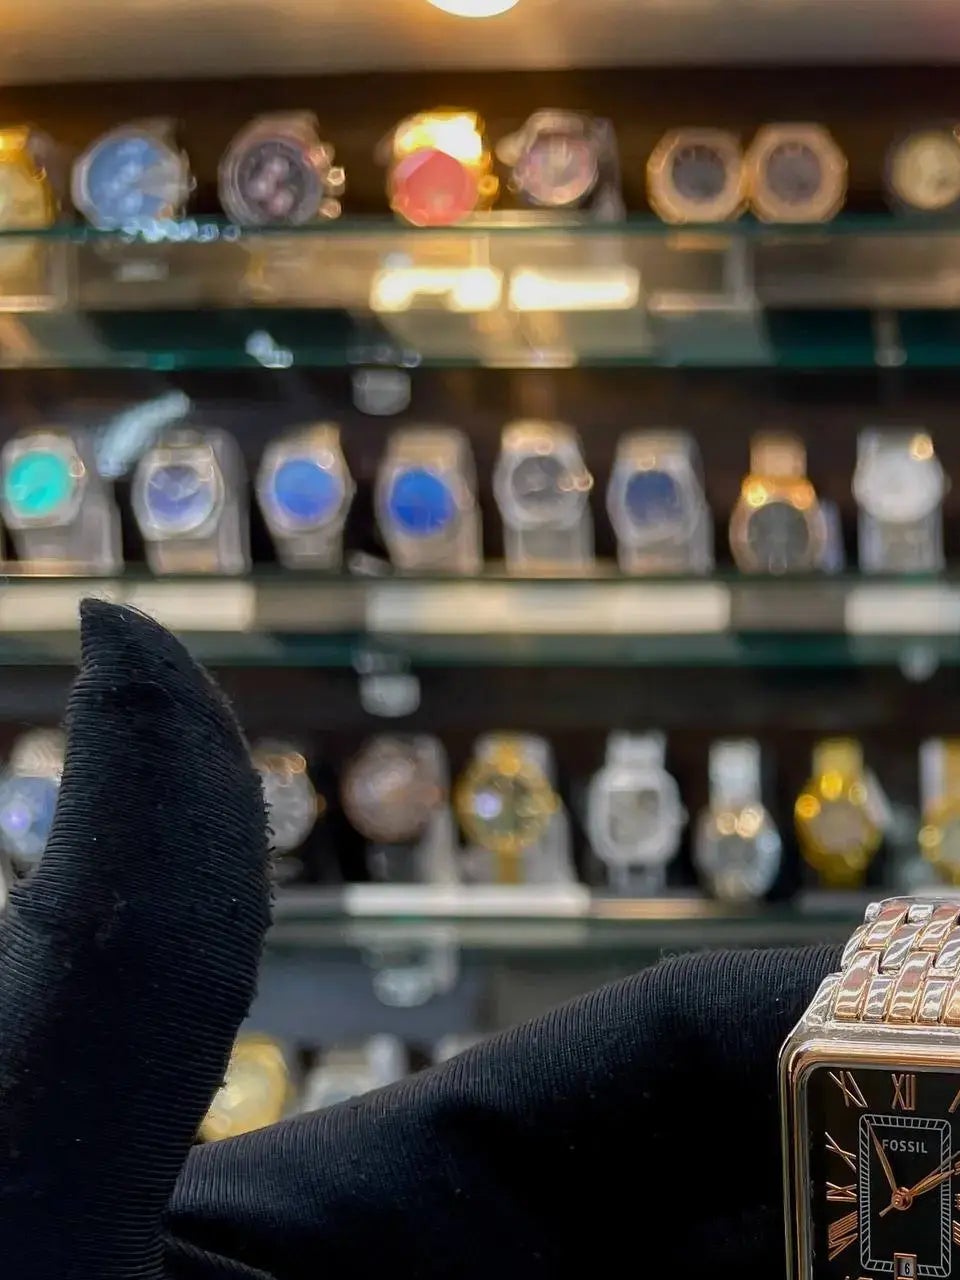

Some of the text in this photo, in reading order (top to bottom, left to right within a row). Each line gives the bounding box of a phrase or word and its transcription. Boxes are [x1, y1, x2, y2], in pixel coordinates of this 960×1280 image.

[891, 1073, 916, 1111] XII
[824, 1131, 857, 1173] X
[882, 1138, 928, 1154] FOSSIL
[826, 1181, 857, 1202] IX
[904, 1262, 911, 1275] 6
